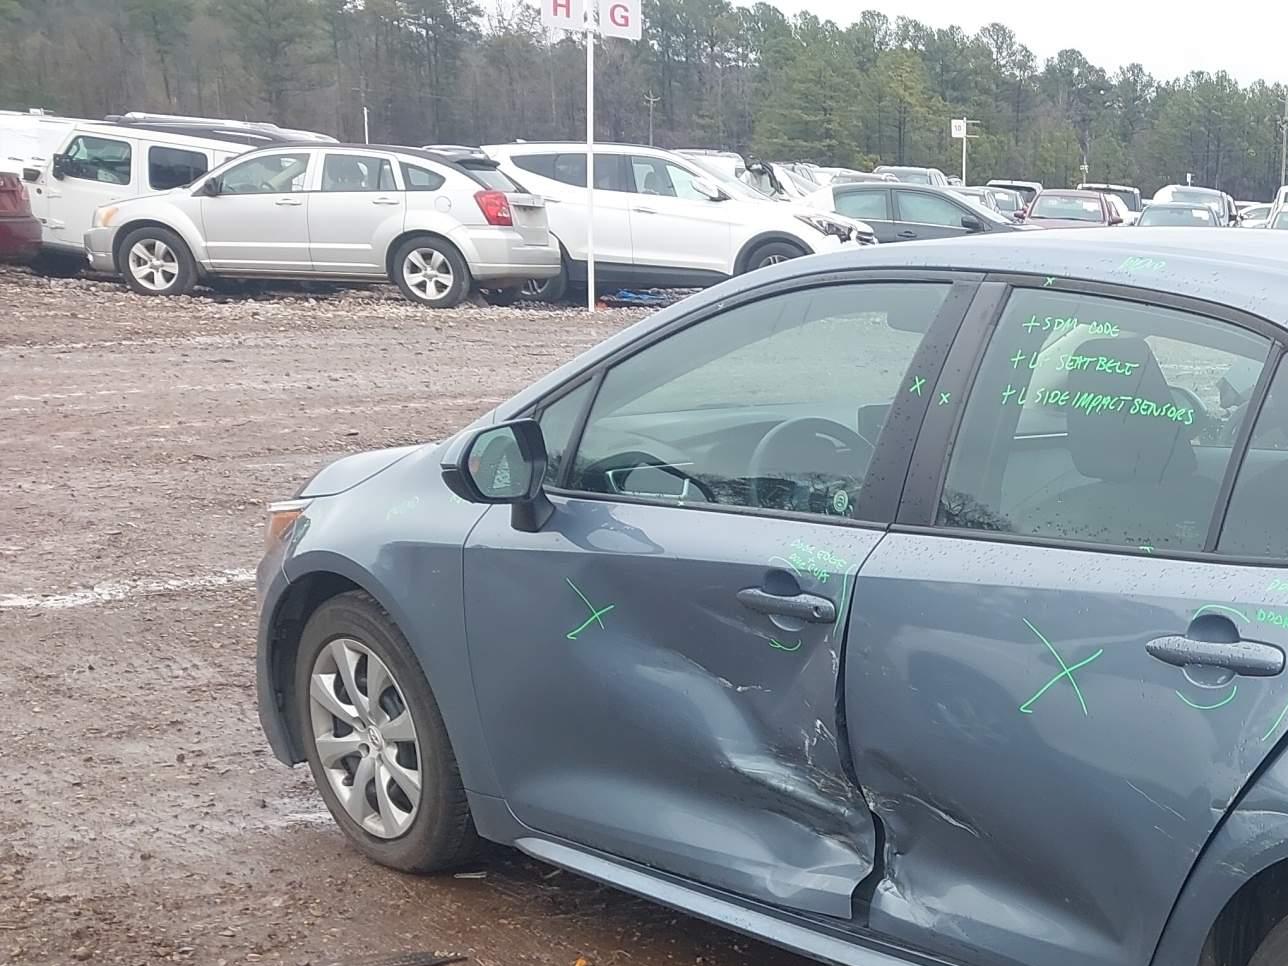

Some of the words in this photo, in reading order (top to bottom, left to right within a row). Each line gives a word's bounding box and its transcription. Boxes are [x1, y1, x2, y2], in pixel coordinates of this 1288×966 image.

[552, 0, 571, 18] H
[609, 3, 630, 27] G
[1088, 320, 1121, 337] CODE
[1035, 389, 1070, 405] SIDE
[1072, 391, 1132, 415] IMPACT
[1130, 396, 1195, 425] SENSORS
